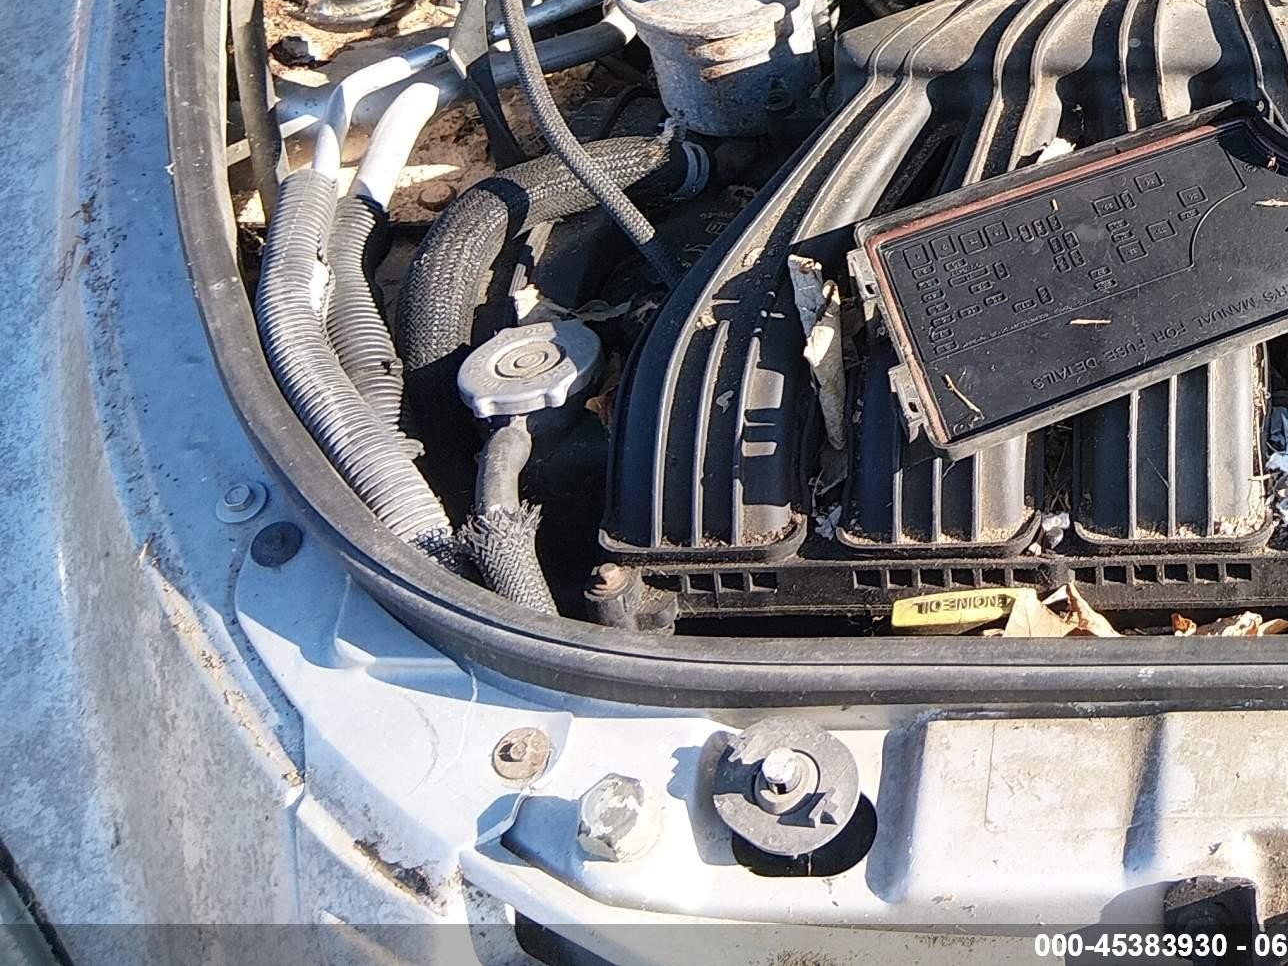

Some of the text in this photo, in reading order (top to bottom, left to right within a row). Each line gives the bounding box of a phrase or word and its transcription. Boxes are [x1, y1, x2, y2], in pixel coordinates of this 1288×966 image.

[1192, 296, 1256, 329] MANUAL
[1152, 322, 1188, 343] FOR
[1103, 338, 1149, 362] FUSE
[1031, 355, 1099, 390] DETAILS
[912, 594, 1008, 615] ENGINE OIL
